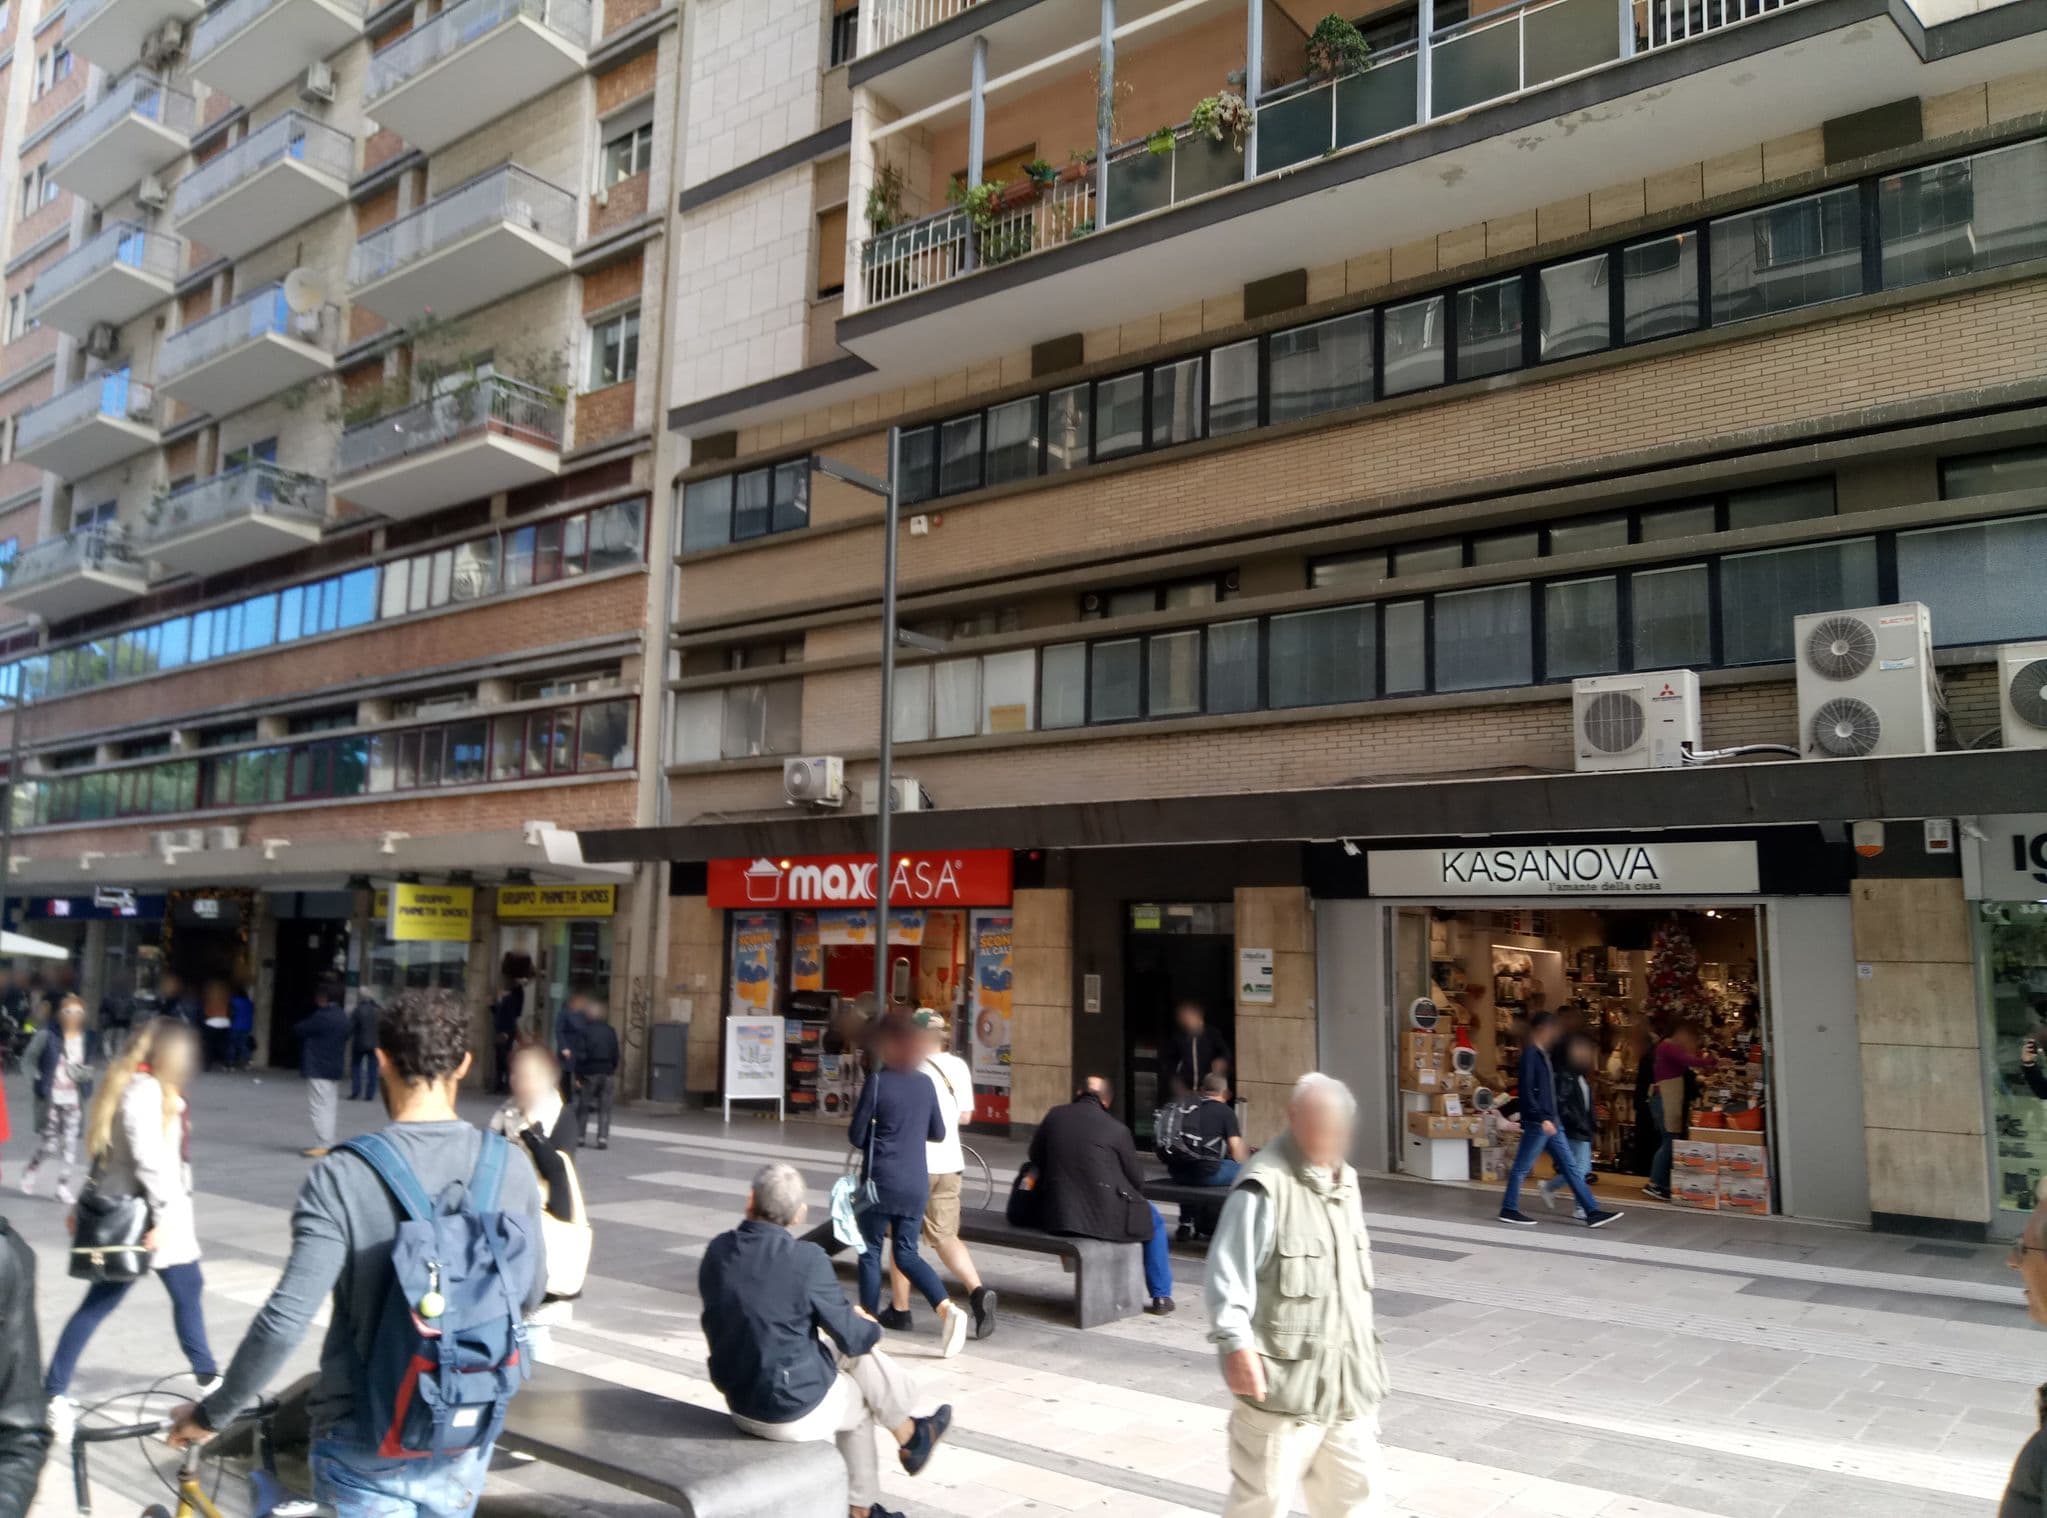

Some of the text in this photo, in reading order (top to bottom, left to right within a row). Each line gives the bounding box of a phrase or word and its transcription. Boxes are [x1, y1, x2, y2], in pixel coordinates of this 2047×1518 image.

[1442, 847, 1659, 882] KASANOVA
[1548, 881, 1662, 892] l'amante della casa
